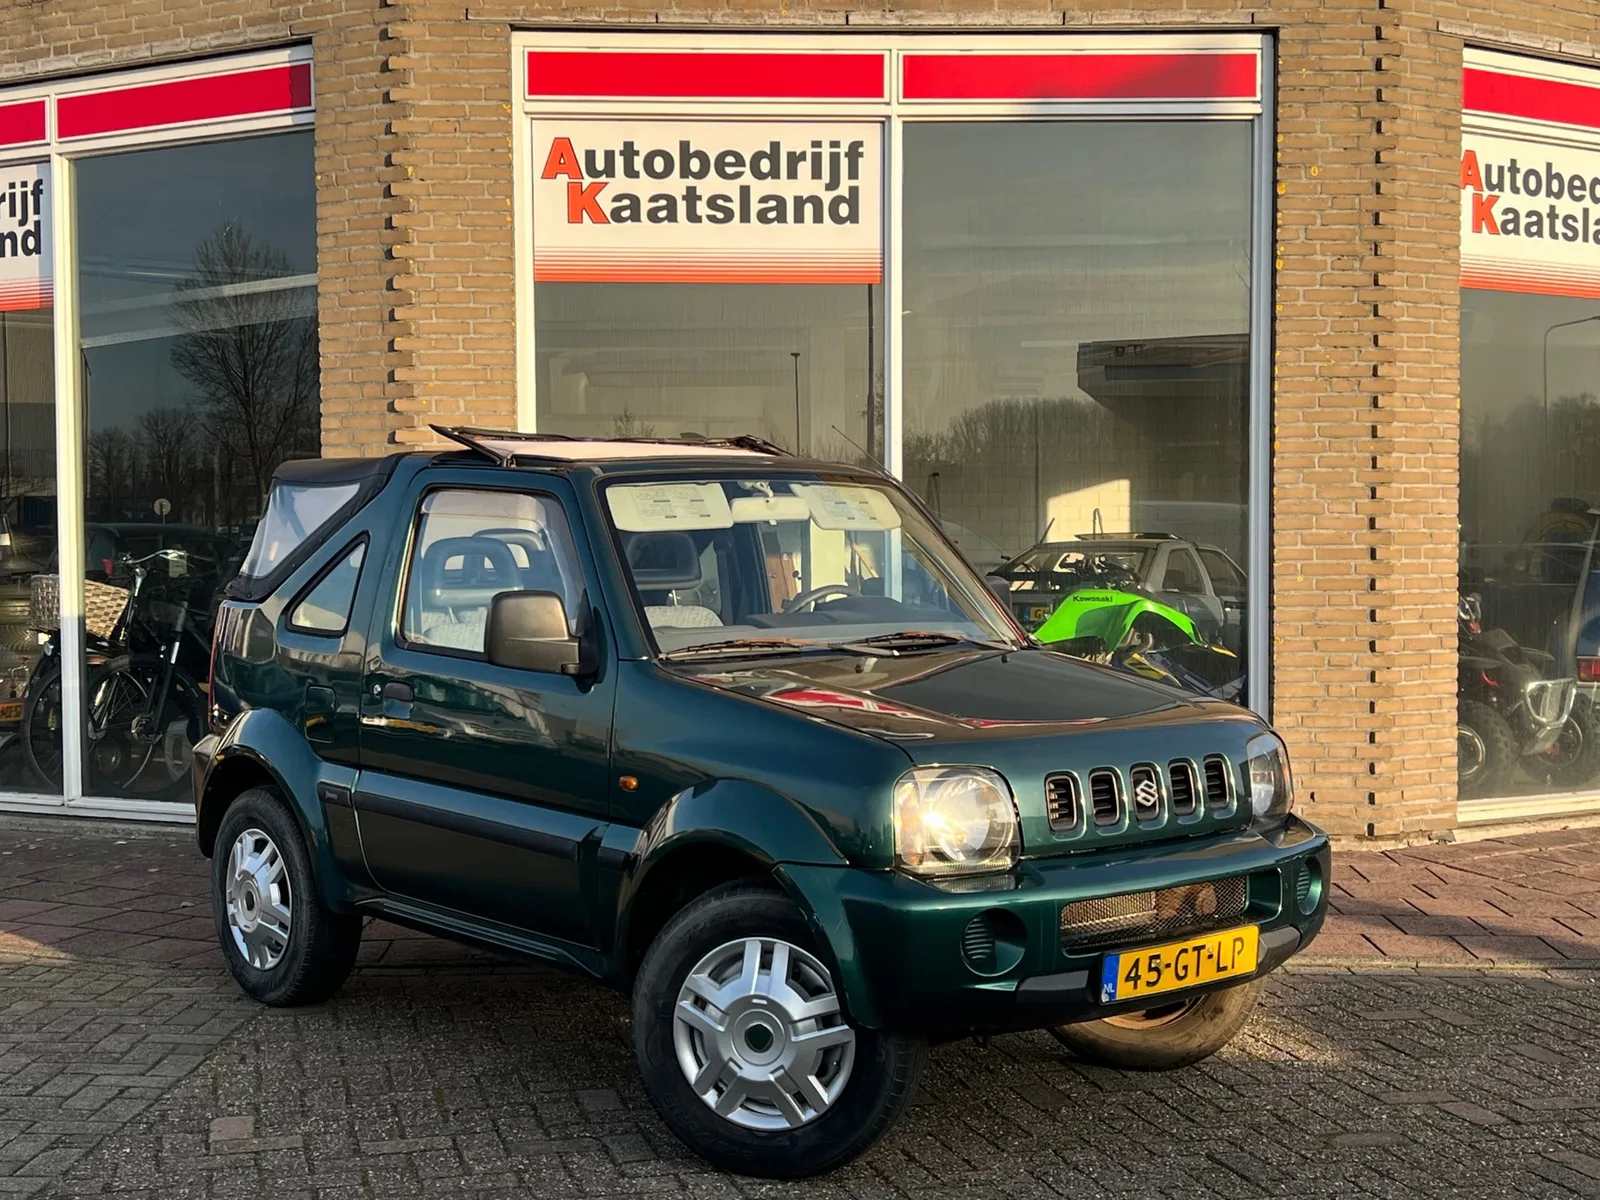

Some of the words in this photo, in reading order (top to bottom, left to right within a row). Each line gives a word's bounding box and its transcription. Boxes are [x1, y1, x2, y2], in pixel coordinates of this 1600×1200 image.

[541, 137, 864, 191] Autobedrijf
[567, 181, 860, 225] Kaatsland
[1072, 595, 1114, 603] Kawasaki
[1103, 982, 1116, 994] NL
[1124, 936, 1245, 990] 45-GT-LP
